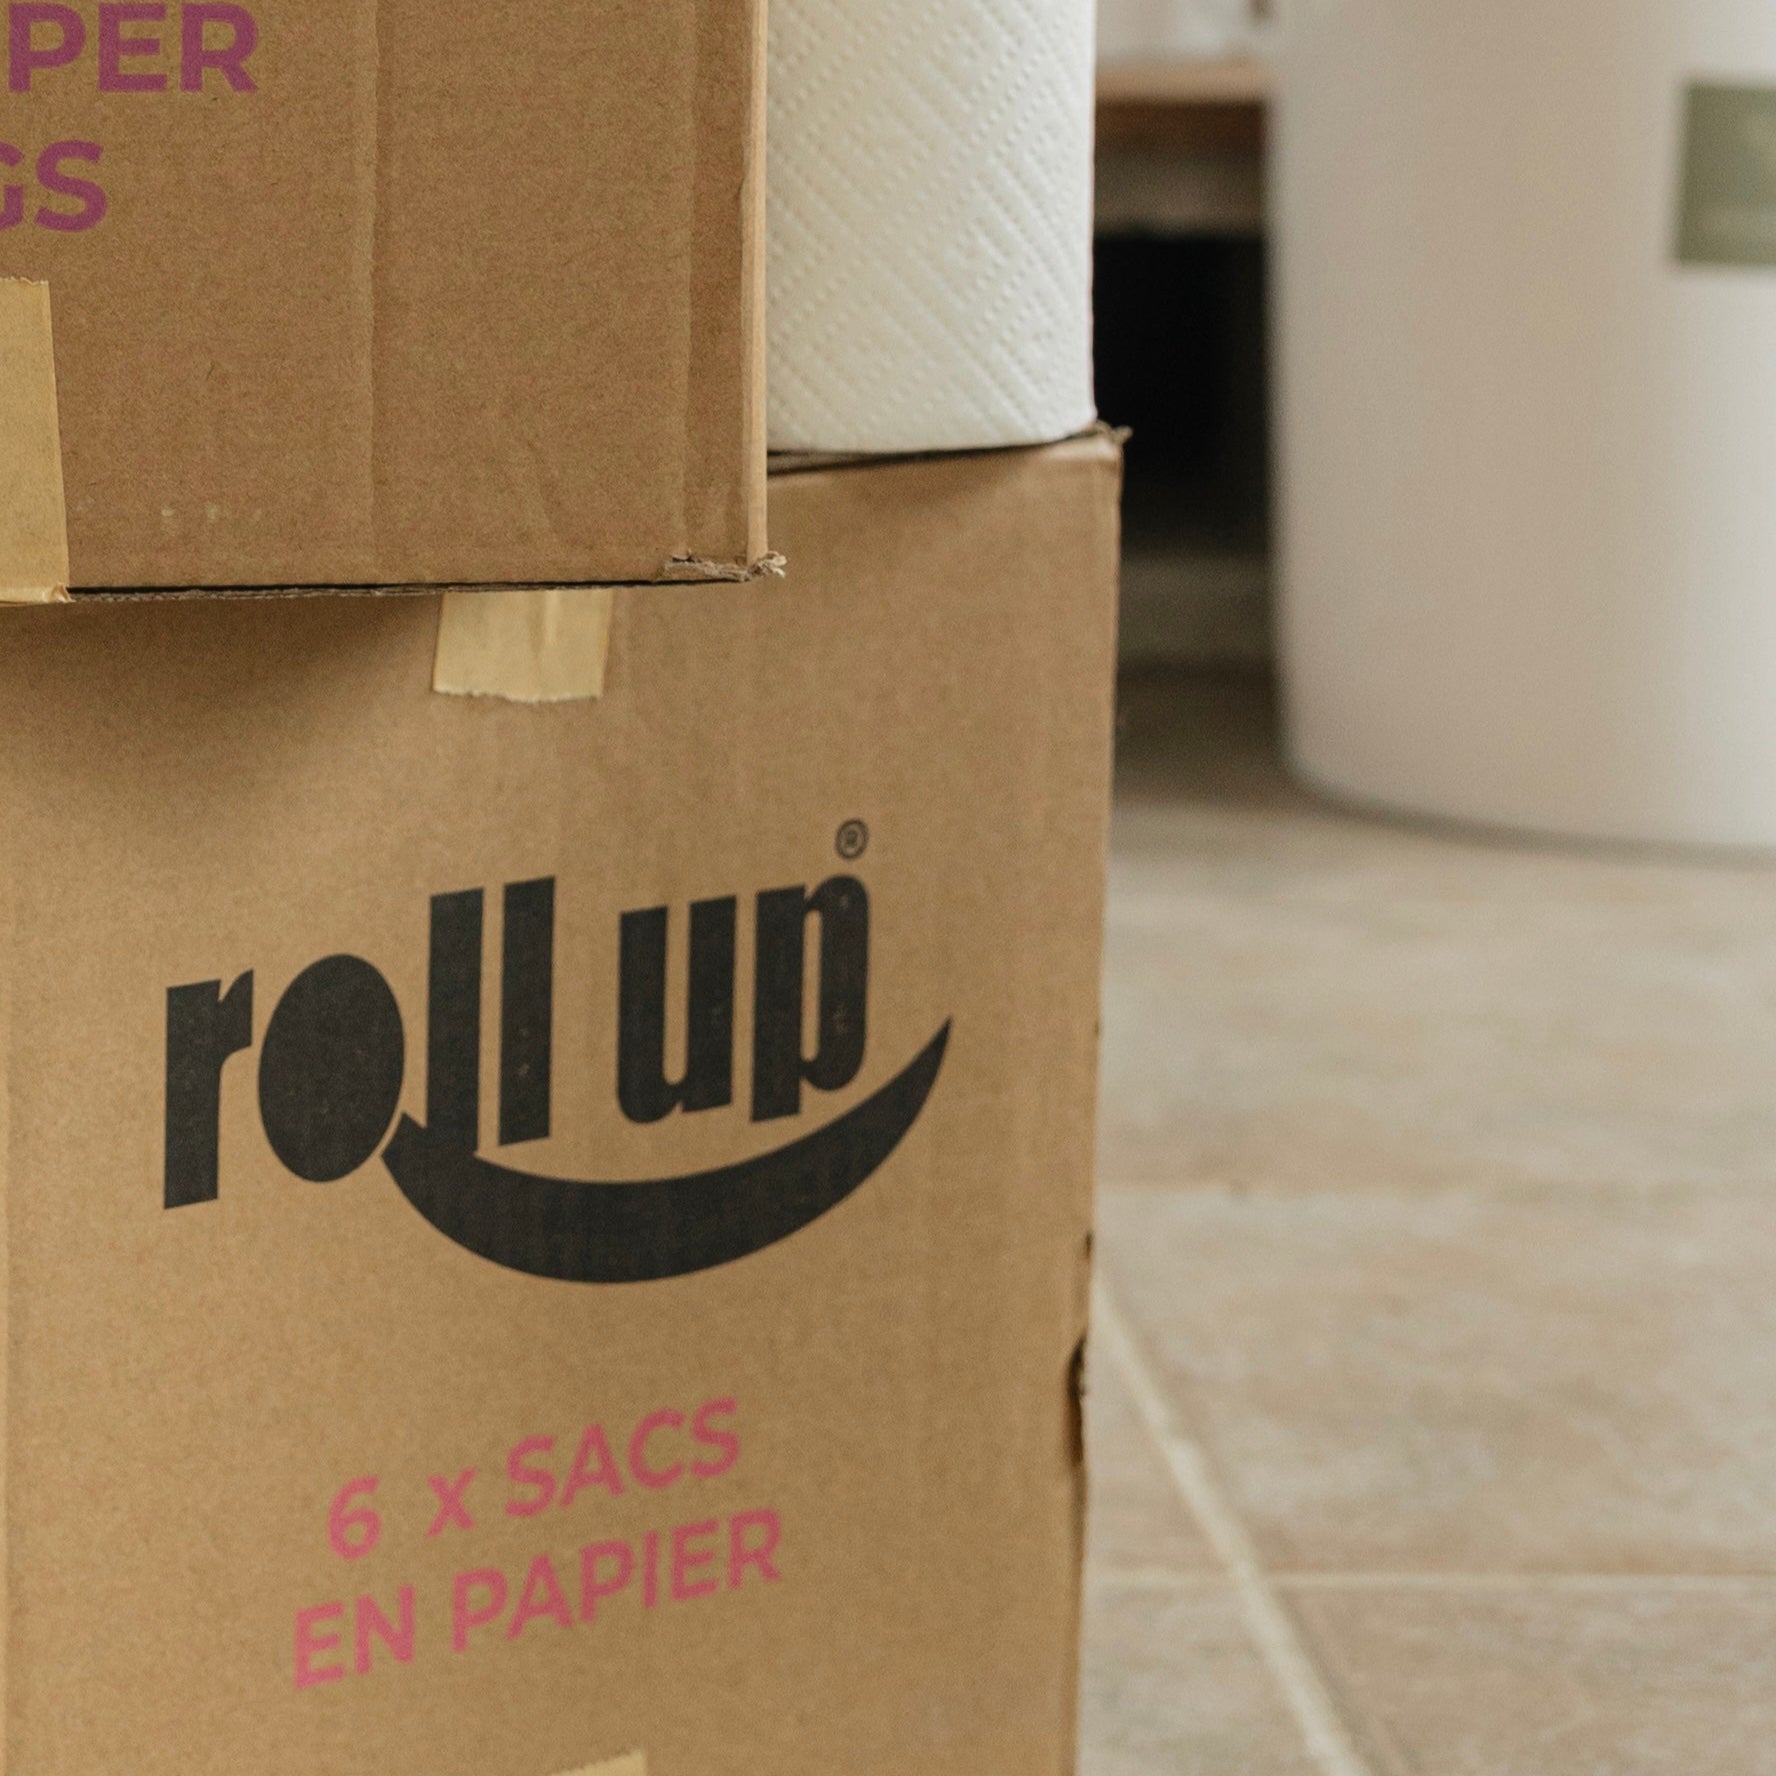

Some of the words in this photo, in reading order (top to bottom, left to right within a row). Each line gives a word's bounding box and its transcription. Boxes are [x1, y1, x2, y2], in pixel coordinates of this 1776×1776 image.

[163, 874, 557, 1211] roll
[617, 872, 871, 1124] up
[327, 1474, 384, 1561] 6
[504, 1396, 742, 1518] SACS
[293, 1583, 416, 1691] EN
[450, 1507, 783, 1654] PAPIER
